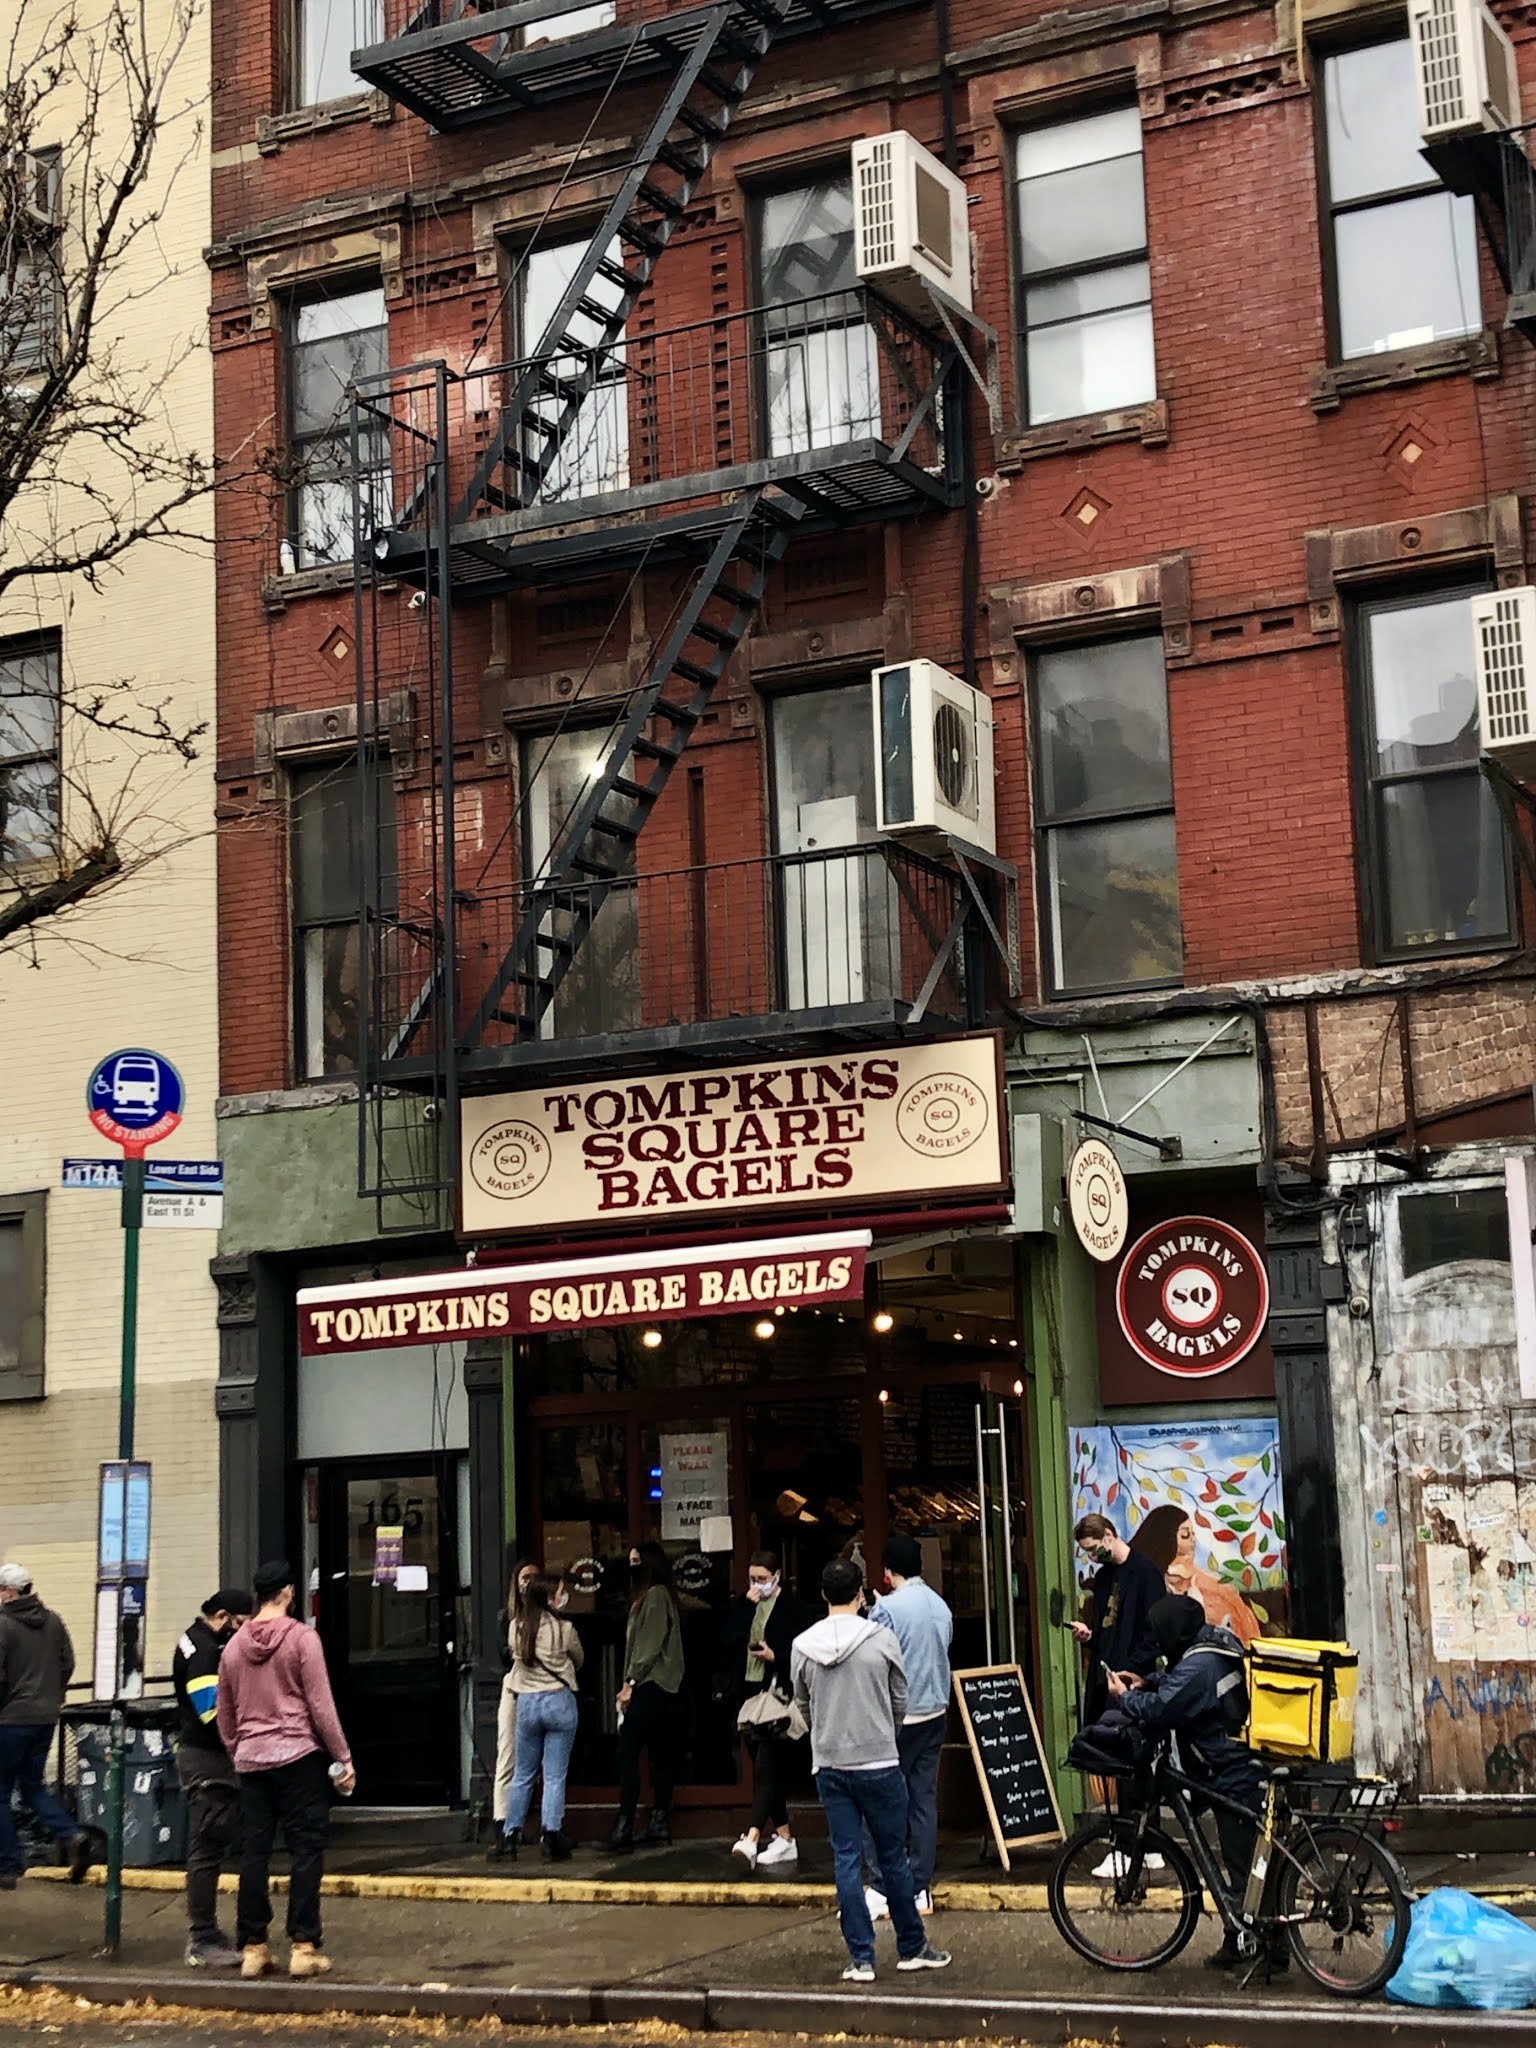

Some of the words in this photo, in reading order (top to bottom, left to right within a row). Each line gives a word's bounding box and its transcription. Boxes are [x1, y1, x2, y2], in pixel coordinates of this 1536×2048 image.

[545, 1059, 900, 1134] TOMPKINS
[906, 1083, 977, 1113] TOMPKINS
[97, 1113, 115, 1131] NO
[113, 1115, 174, 1140] STANDING
[930, 1110, 953, 1120] SQ
[479, 1129, 542, 1156] TOMPKINS
[583, 1104, 864, 1170] SQUARE
[916, 1128, 971, 1148] BAGELS
[148, 1164, 177, 1174] Lower
[178, 1164, 198, 1175] East
[199, 1165, 219, 1175] Side
[500, 1155, 520, 1164] SQ
[67, 1164, 118, 1185] M14A
[486, 1173, 535, 1191] BAGELS
[597, 1148, 853, 1211] BAGELS
[1075, 1152, 1122, 1195] TOMPKINS
[147, 1197, 182, 1206] Avenue
[187, 1197, 195, 1206] A
[147, 1207, 168, 1216] East
[1091, 1193, 1107, 1208] SQ
[1083, 1222, 1119, 1250] BAGELS
[1138, 1236, 1244, 1282] TOMPKINS
[310, 1291, 510, 1344] TOMPKINS
[529, 1274, 687, 1325] SQUARE
[699, 1256, 852, 1307] BAGELS
[1171, 1286, 1212, 1309] SQ
[1145, 1313, 1242, 1357] BAGELS
[673, 1446, 713, 1456] PLEASE
[362, 1494, 424, 1532] 165
[676, 1501, 684, 1511] A
[686, 1500, 713, 1511] FACE
[680, 1516, 705, 1527] MAS
